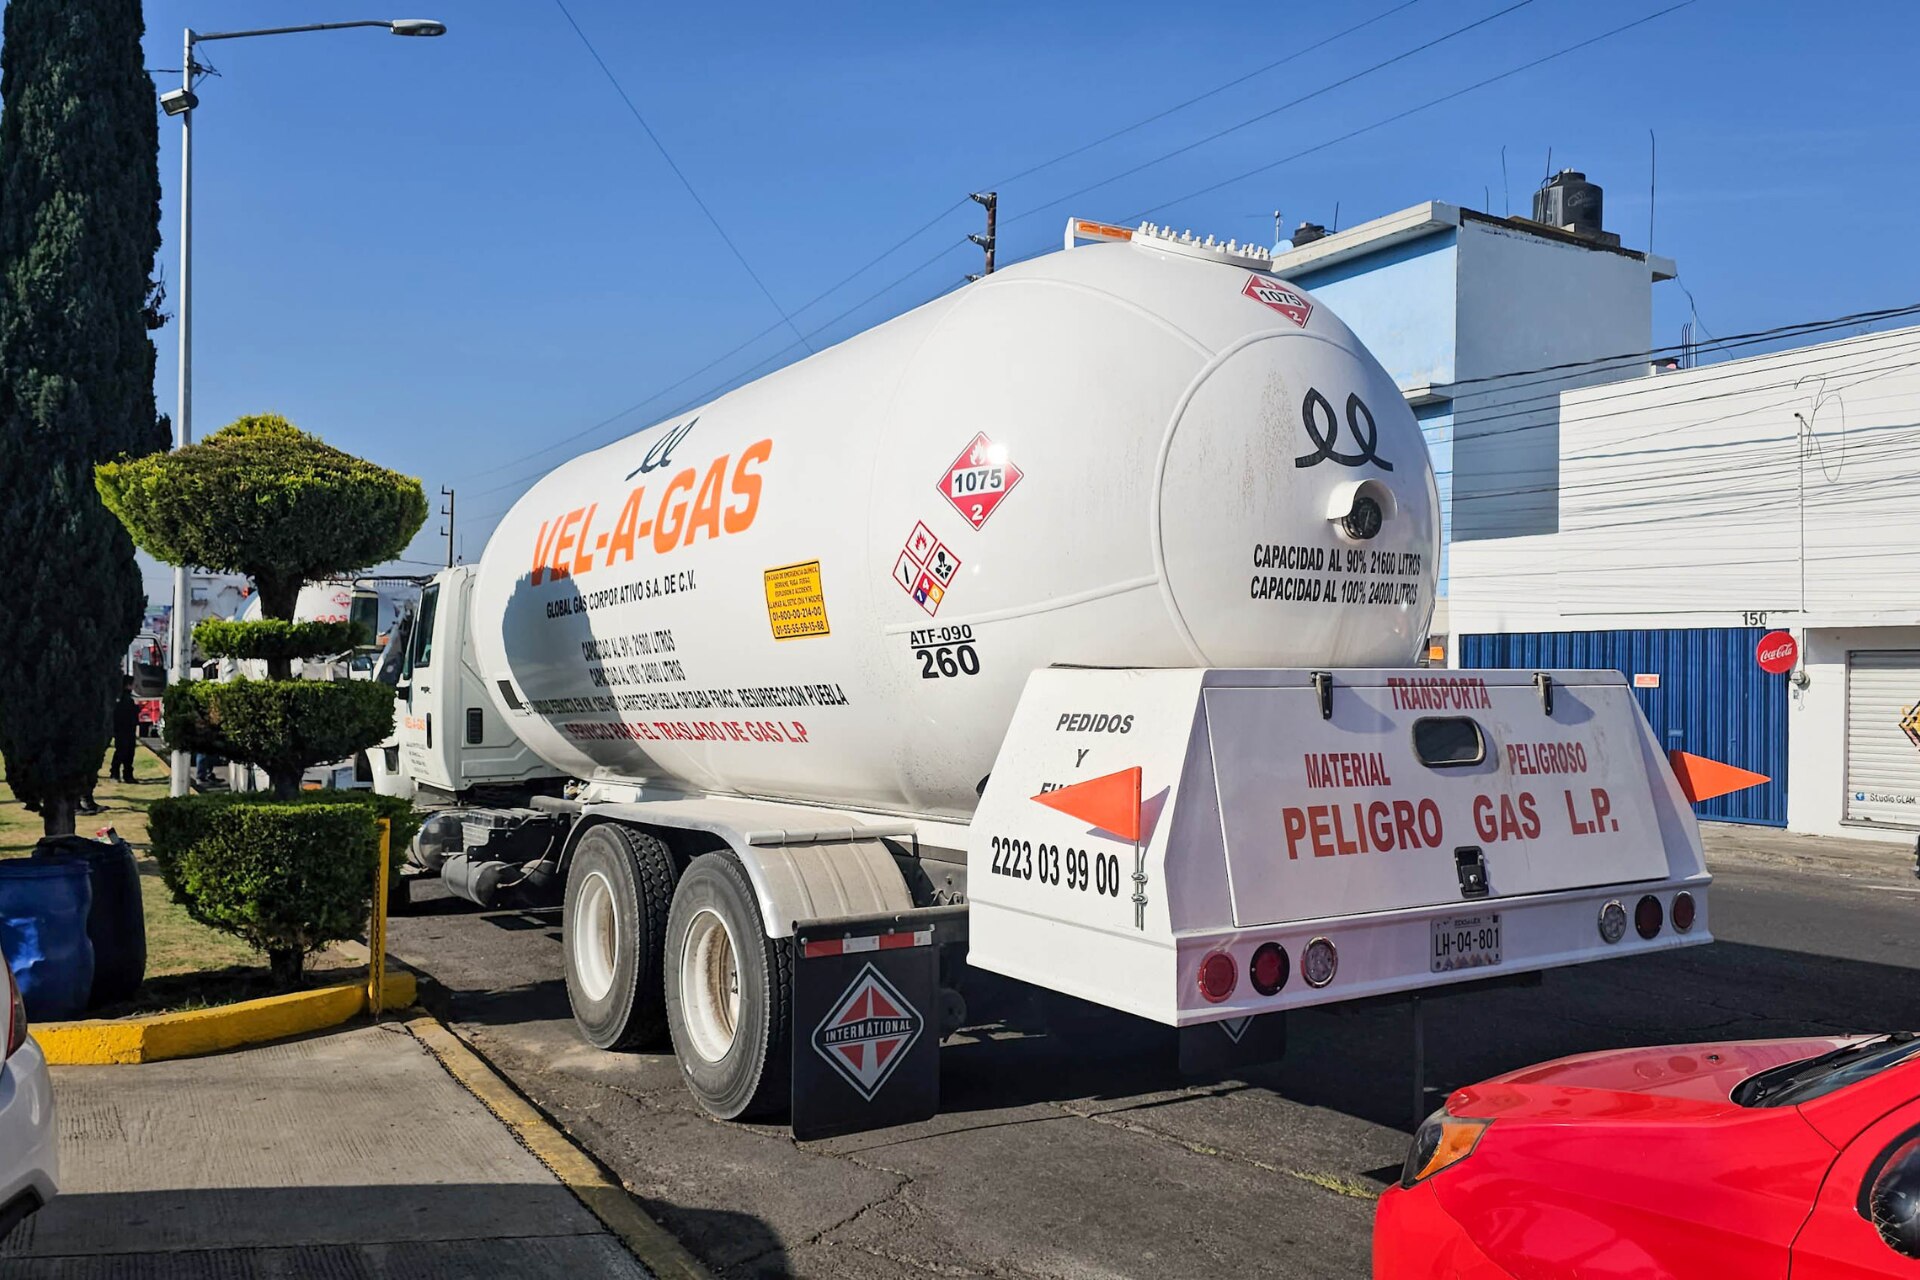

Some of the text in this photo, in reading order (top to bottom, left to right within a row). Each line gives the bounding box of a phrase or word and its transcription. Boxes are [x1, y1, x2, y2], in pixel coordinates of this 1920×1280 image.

[1260, 290, 1302, 306] 1075
[1288, 310, 1303, 322] 2
[954, 468, 1002, 493] 1075
[531, 438, 773, 587] VEL-A-GAS
[971, 504, 983, 520] 2
[1253, 544, 1421, 576] CAPACIDAD AL 90% 21600 LITROS
[546, 569, 697, 619] GLOBAL GAS CORPORATIVO S.A. DE C.V.
[922, 578, 930, 590] 4
[1250, 576, 1418, 605] CAPACIDAD AL 100% 24000 LITROS
[916, 589, 923, 602] 1
[1742, 611, 1768, 626] 150
[910, 624, 973, 645] ATF-090
[916, 644, 980, 679] 260
[1760, 642, 1794, 663] Coca-Cola
[803, 683, 850, 706] PUEBLA
[1387, 677, 1492, 710] TRANSPORTA
[607, 722, 643, 741] PARA
[637, 722, 660, 741] EL
[654, 721, 727, 741] TRASLADO
[721, 721, 751, 742] DE
[745, 721, 784, 743] GAS
[1056, 713, 1134, 734] PEDIDOS
[1075, 748, 1090, 768] Y
[1304, 742, 1588, 788] MATERIAL PELIGROSO
[1281, 788, 1620, 861] PELIGRO GAS L.P.
[991, 836, 1119, 897] 2223 03 99 00
[1435, 927, 1499, 957] LH-04-801
[825, 1020, 911, 1042] INTERNATIONAL
